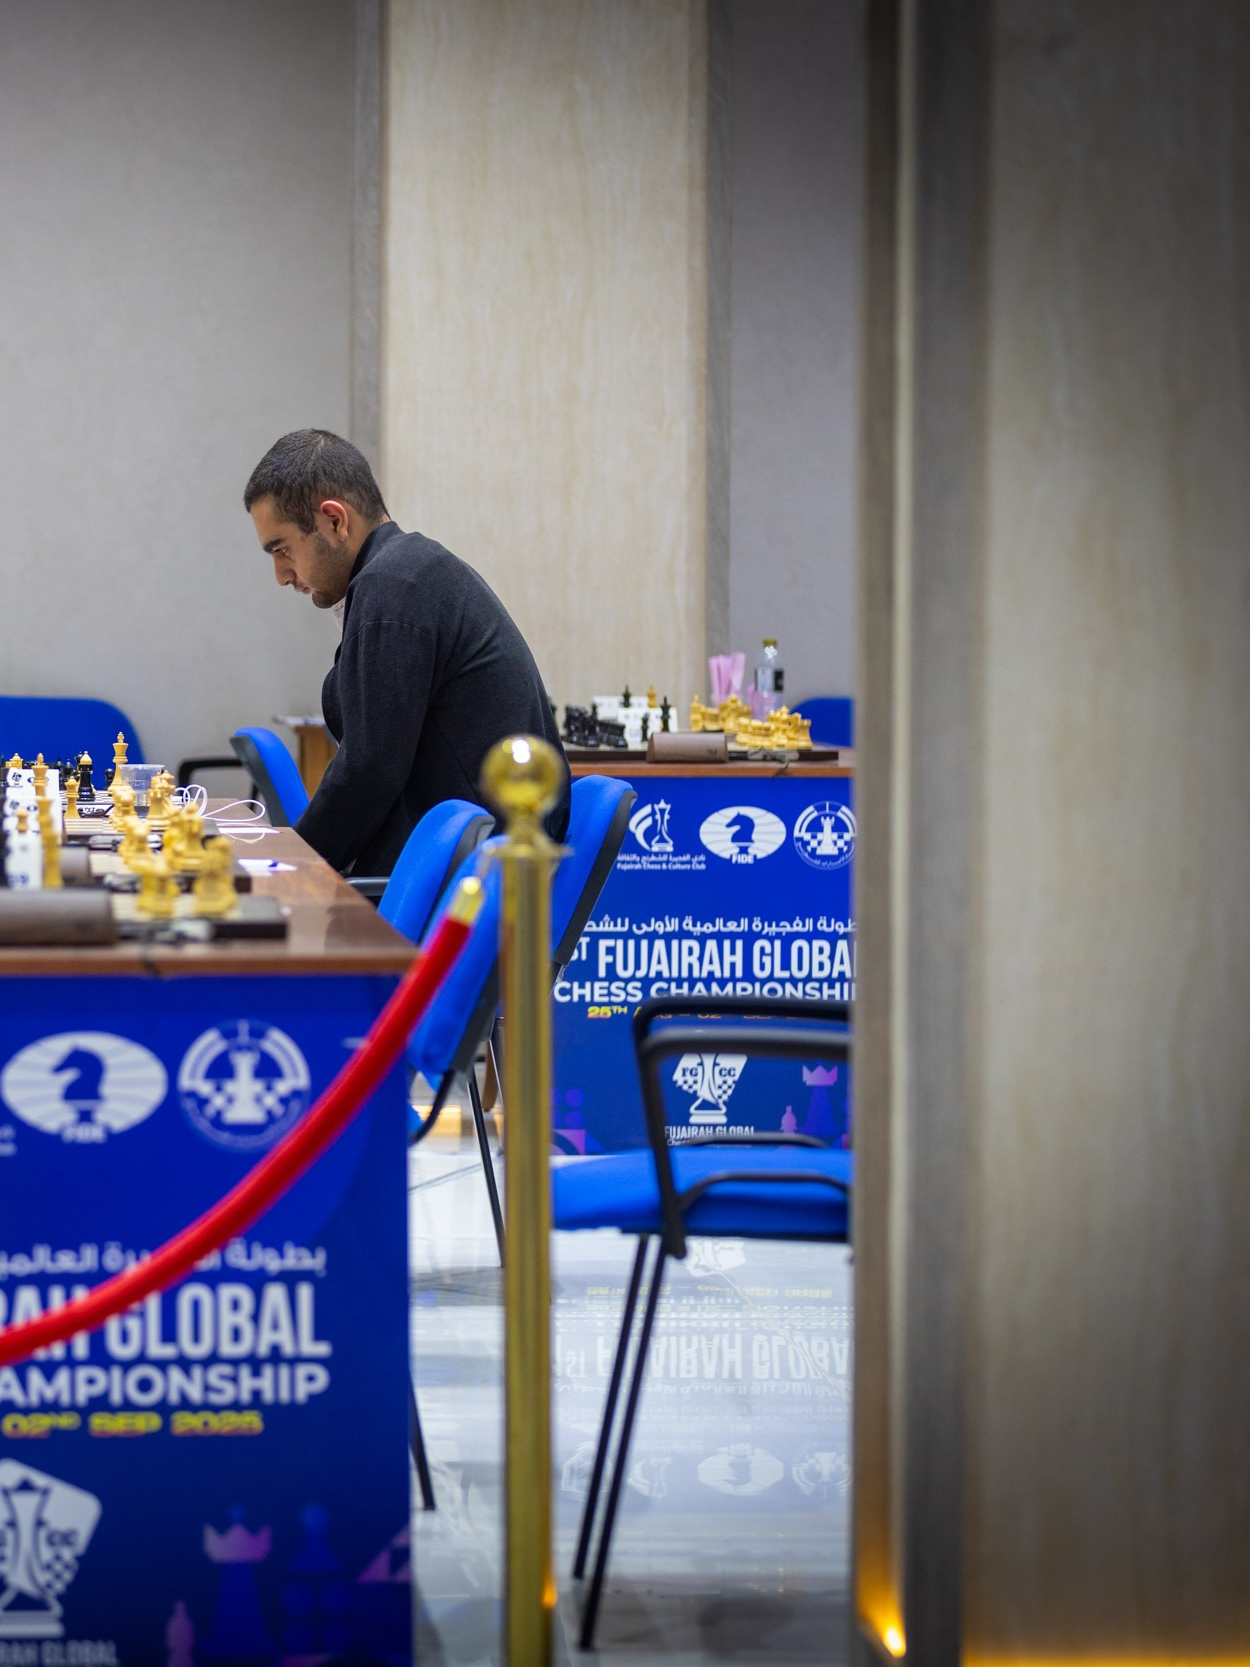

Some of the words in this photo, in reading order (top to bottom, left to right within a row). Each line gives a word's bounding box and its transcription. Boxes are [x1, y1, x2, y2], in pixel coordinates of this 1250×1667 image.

[731, 853, 754, 864] FIDE
[632, 914, 678, 935] الأولى
[682, 915, 748, 936] العالمية
[751, 915, 813, 936] الفجيرة
[816, 915, 857, 935] طولة
[597, 938, 744, 979] FUJAIRAH
[553, 980, 643, 1003] CHESS
[682, 1067, 699, 1077] FG
[719, 1067, 737, 1077] CC
[104, 1281, 333, 1361] GLOBAL
